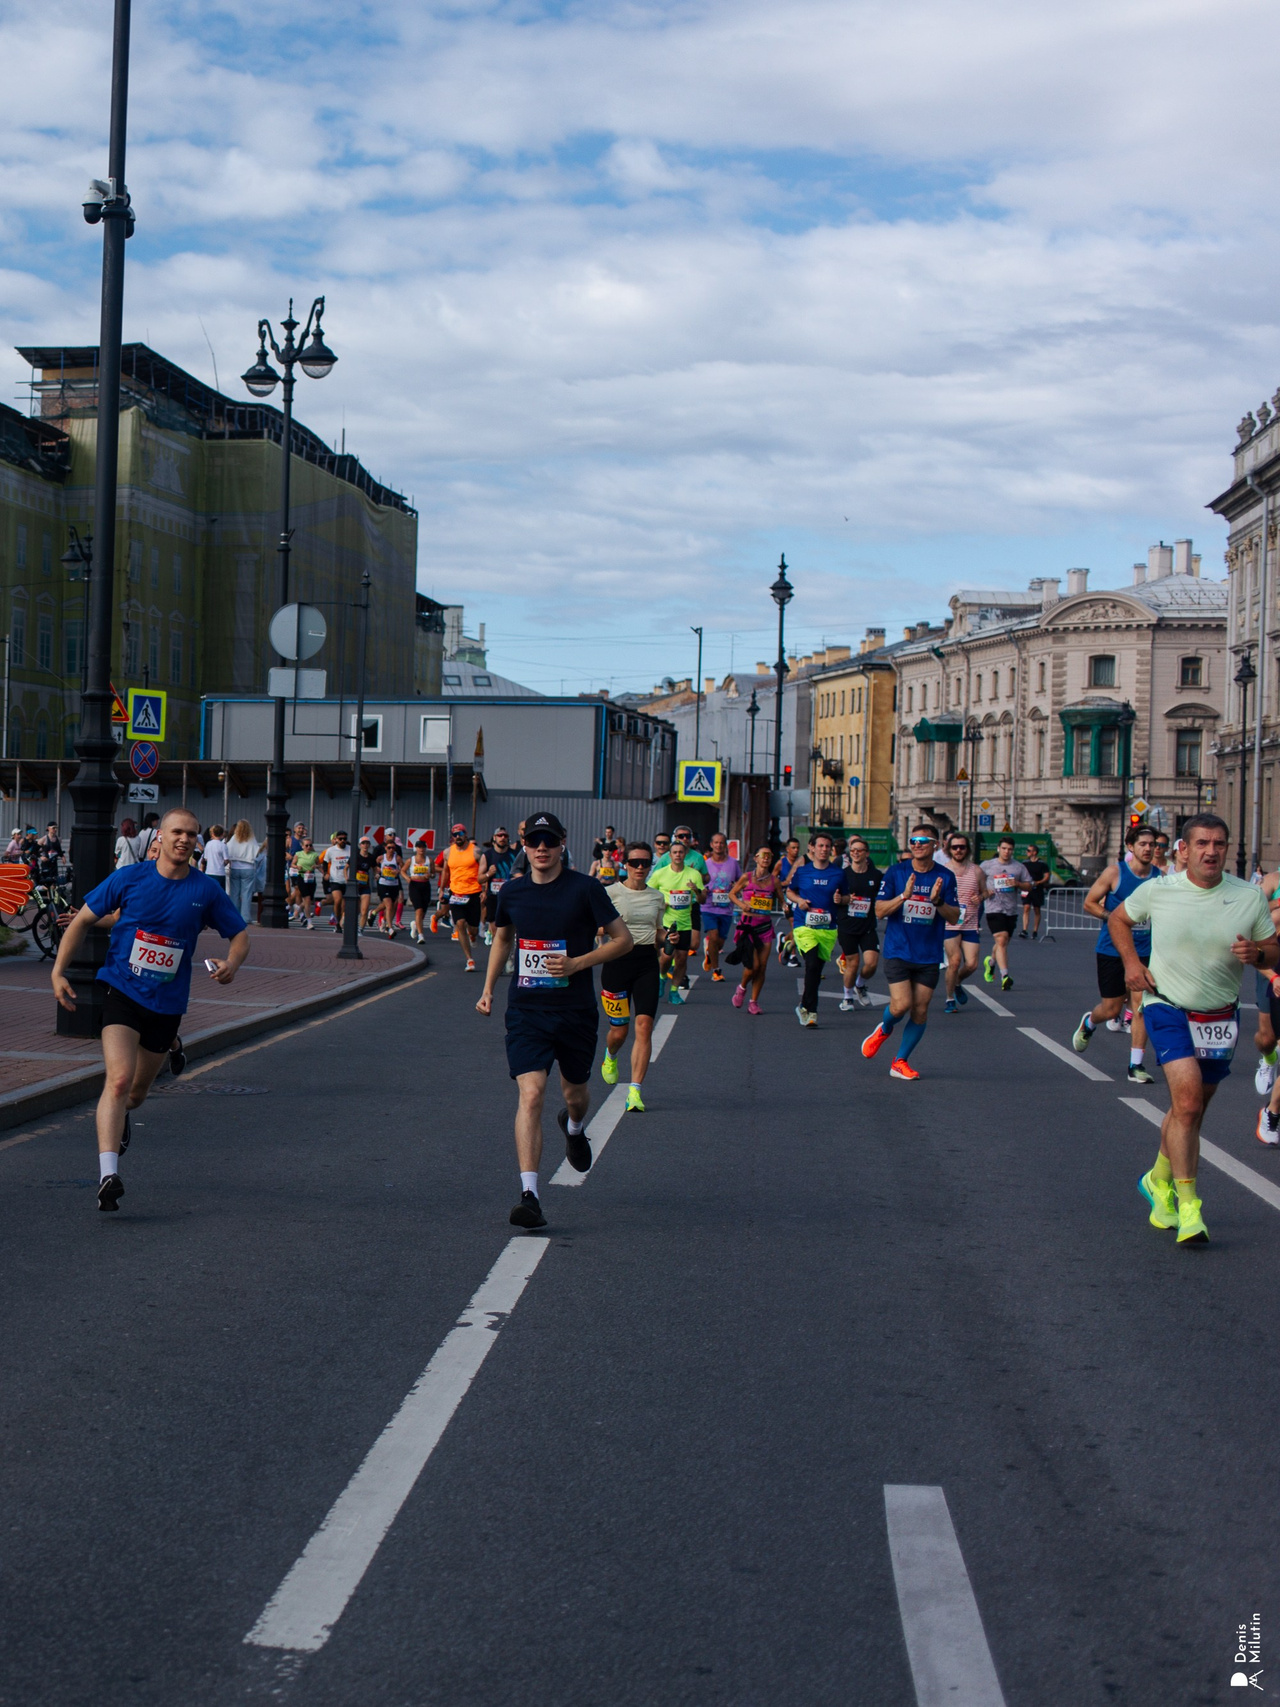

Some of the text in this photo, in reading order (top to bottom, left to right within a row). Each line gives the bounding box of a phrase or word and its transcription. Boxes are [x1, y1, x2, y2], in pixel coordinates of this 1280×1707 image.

[920, 885, 931, 894] БЕГ
[908, 904, 933, 916] 7133
[809, 914, 829, 923] 5890
[138, 947, 174, 967] 7836
[525, 953, 549, 968] 693
[522, 977, 529, 986] C
[605, 1000, 622, 1012] 724
[1196, 1025, 1233, 1040] 1986
[1200, 1049, 1206, 1057] D
